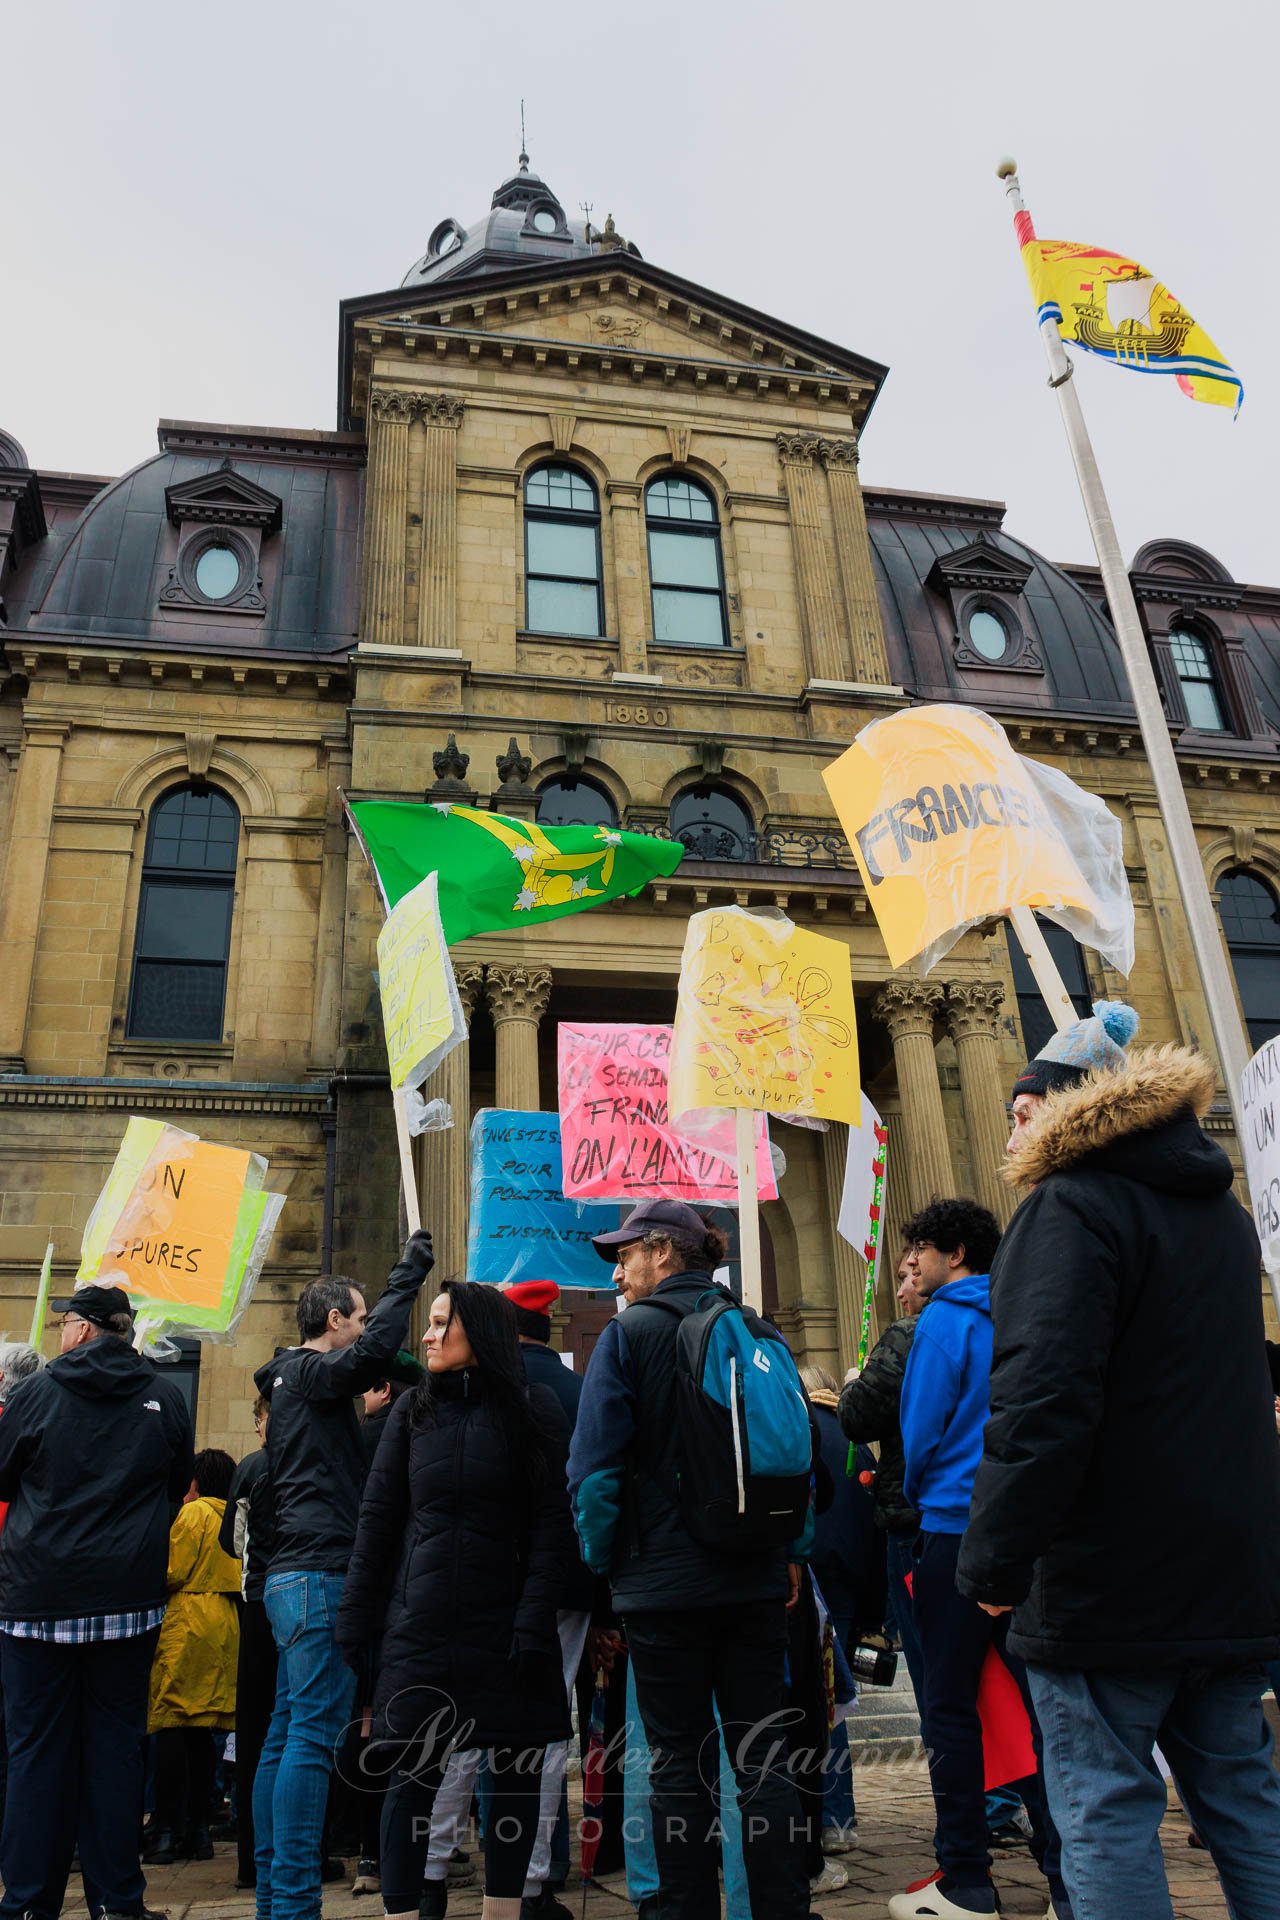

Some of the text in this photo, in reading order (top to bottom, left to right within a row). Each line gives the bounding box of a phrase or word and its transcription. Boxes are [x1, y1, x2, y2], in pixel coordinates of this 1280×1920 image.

[604, 702, 669, 727] 1880
[1253, 1101, 1276, 1153] UN
[500, 1160, 553, 1179] POUR
[569, 1136, 616, 1185] ON
